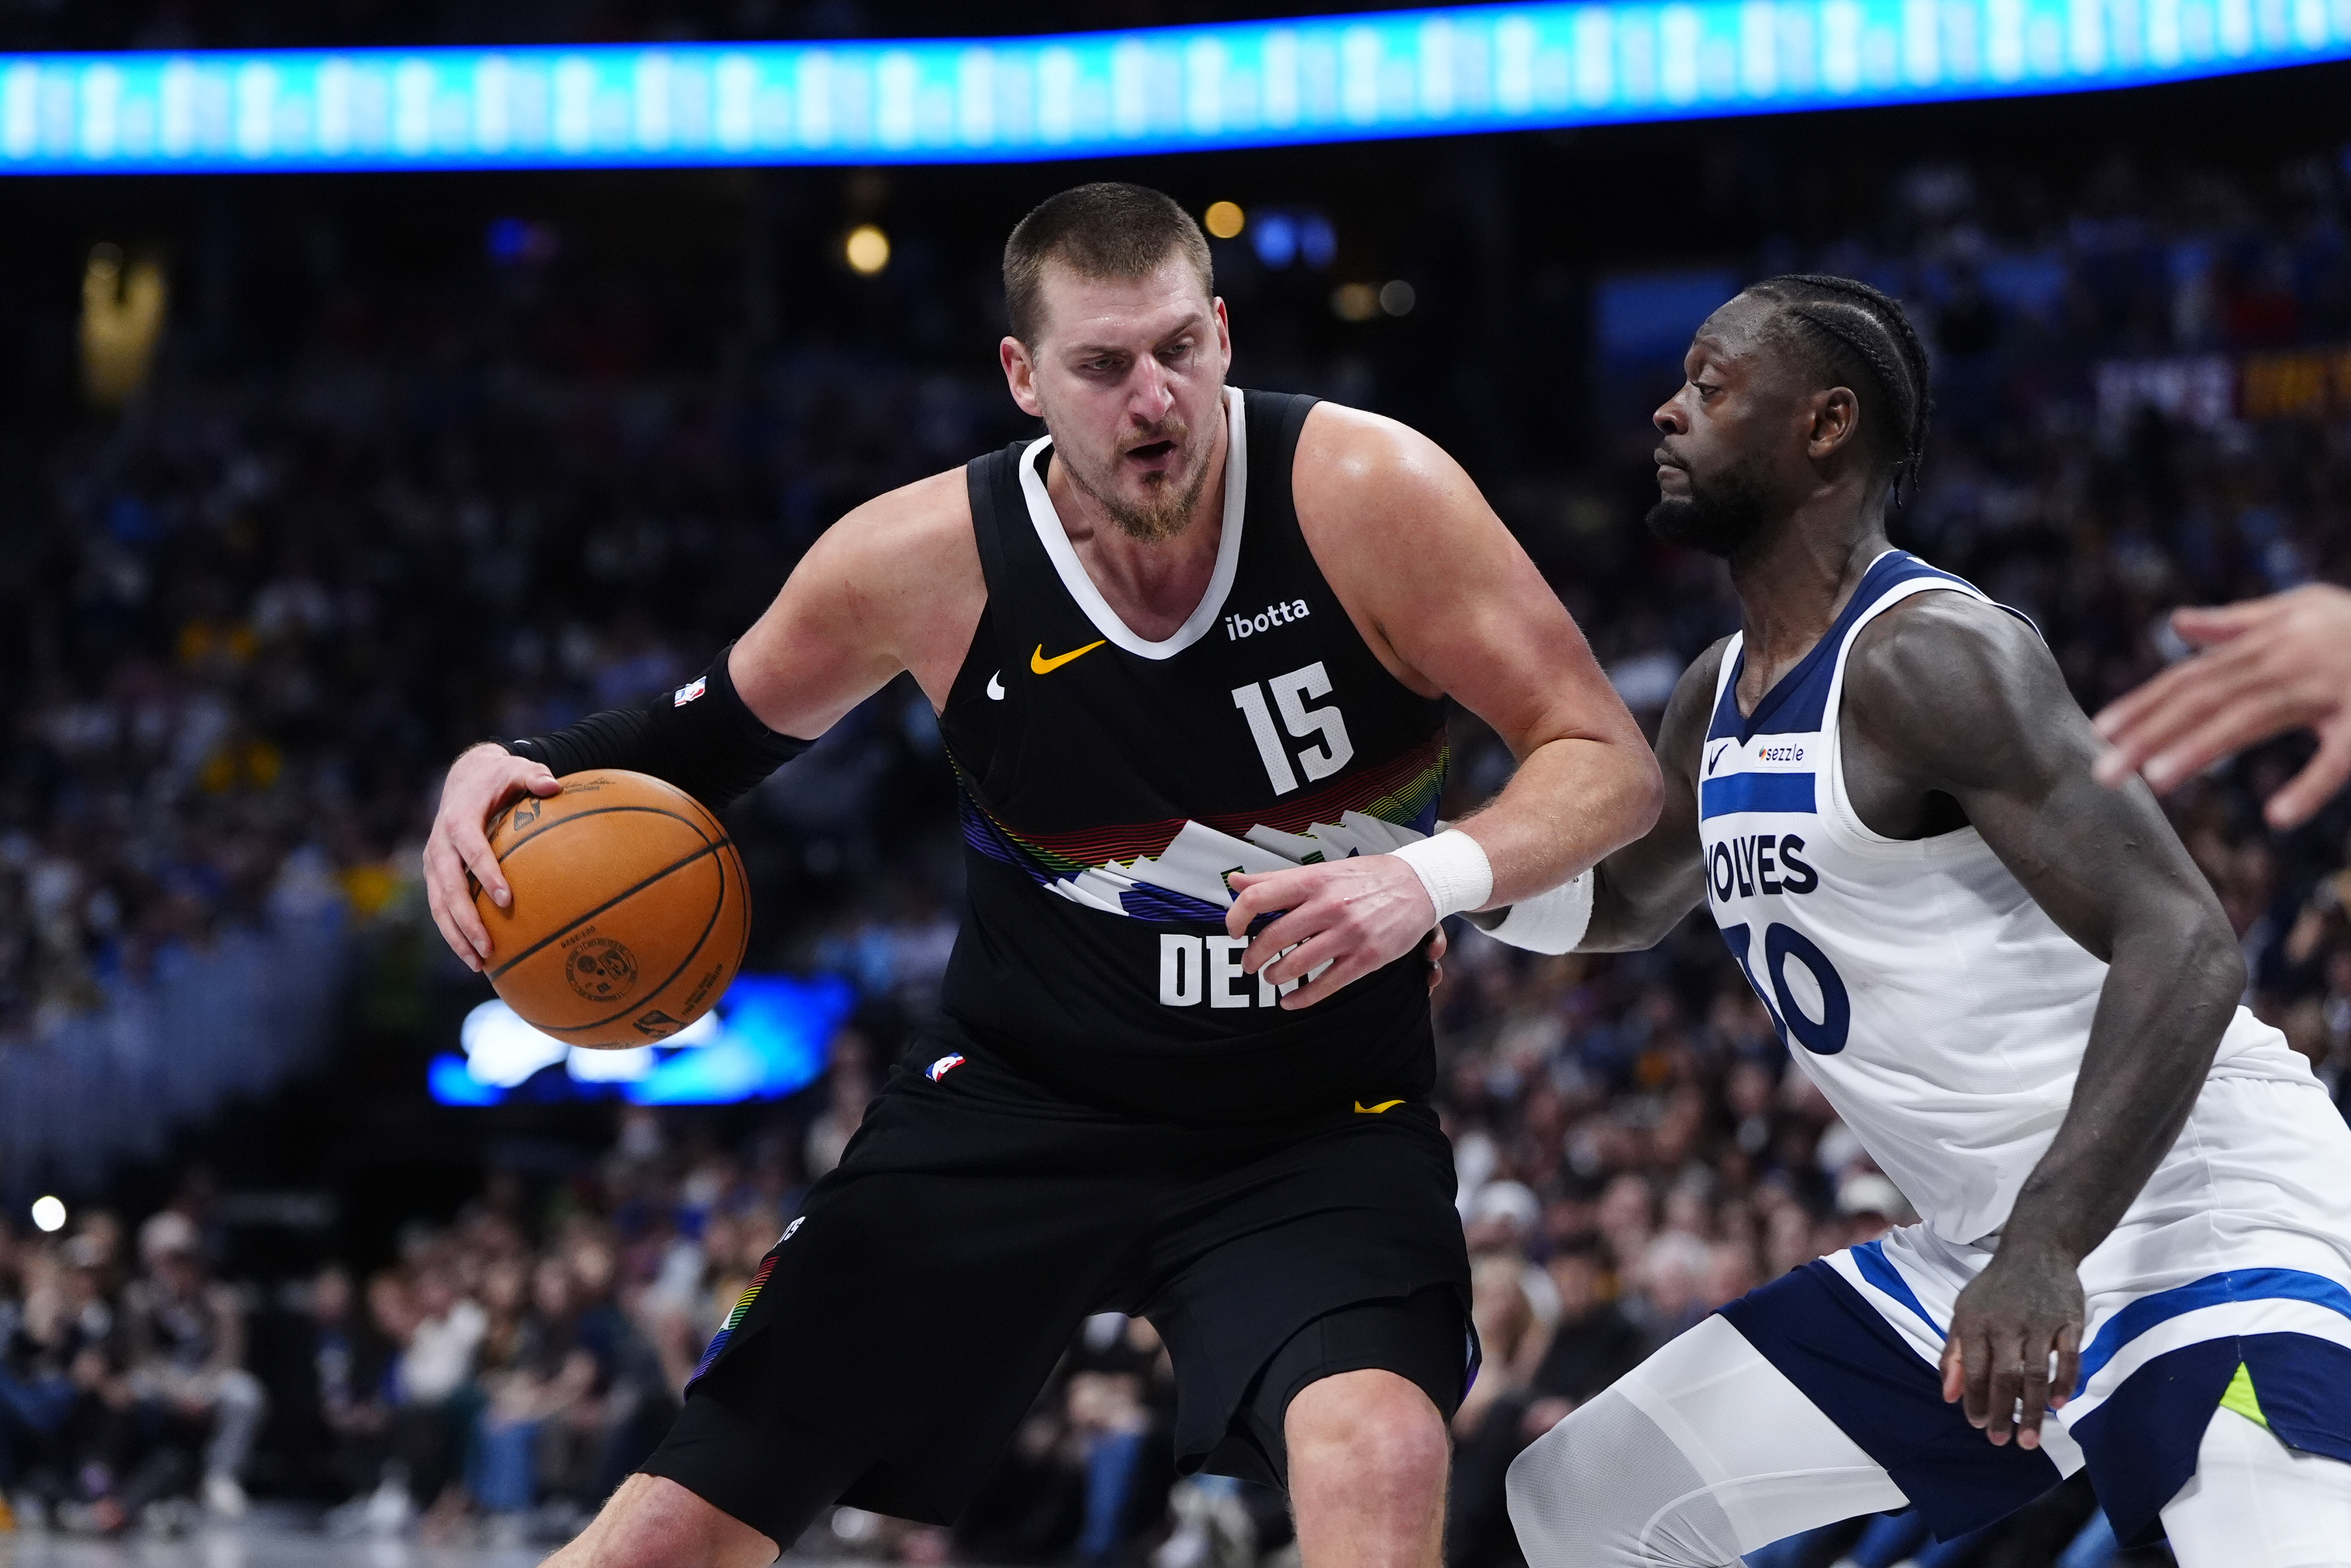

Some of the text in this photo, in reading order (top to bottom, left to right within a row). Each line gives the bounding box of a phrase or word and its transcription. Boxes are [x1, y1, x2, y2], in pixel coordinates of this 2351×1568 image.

[1225, 599, 1310, 641] ibotta
[1231, 661, 1354, 796] 15
[1766, 743, 1803, 761] sezzle
